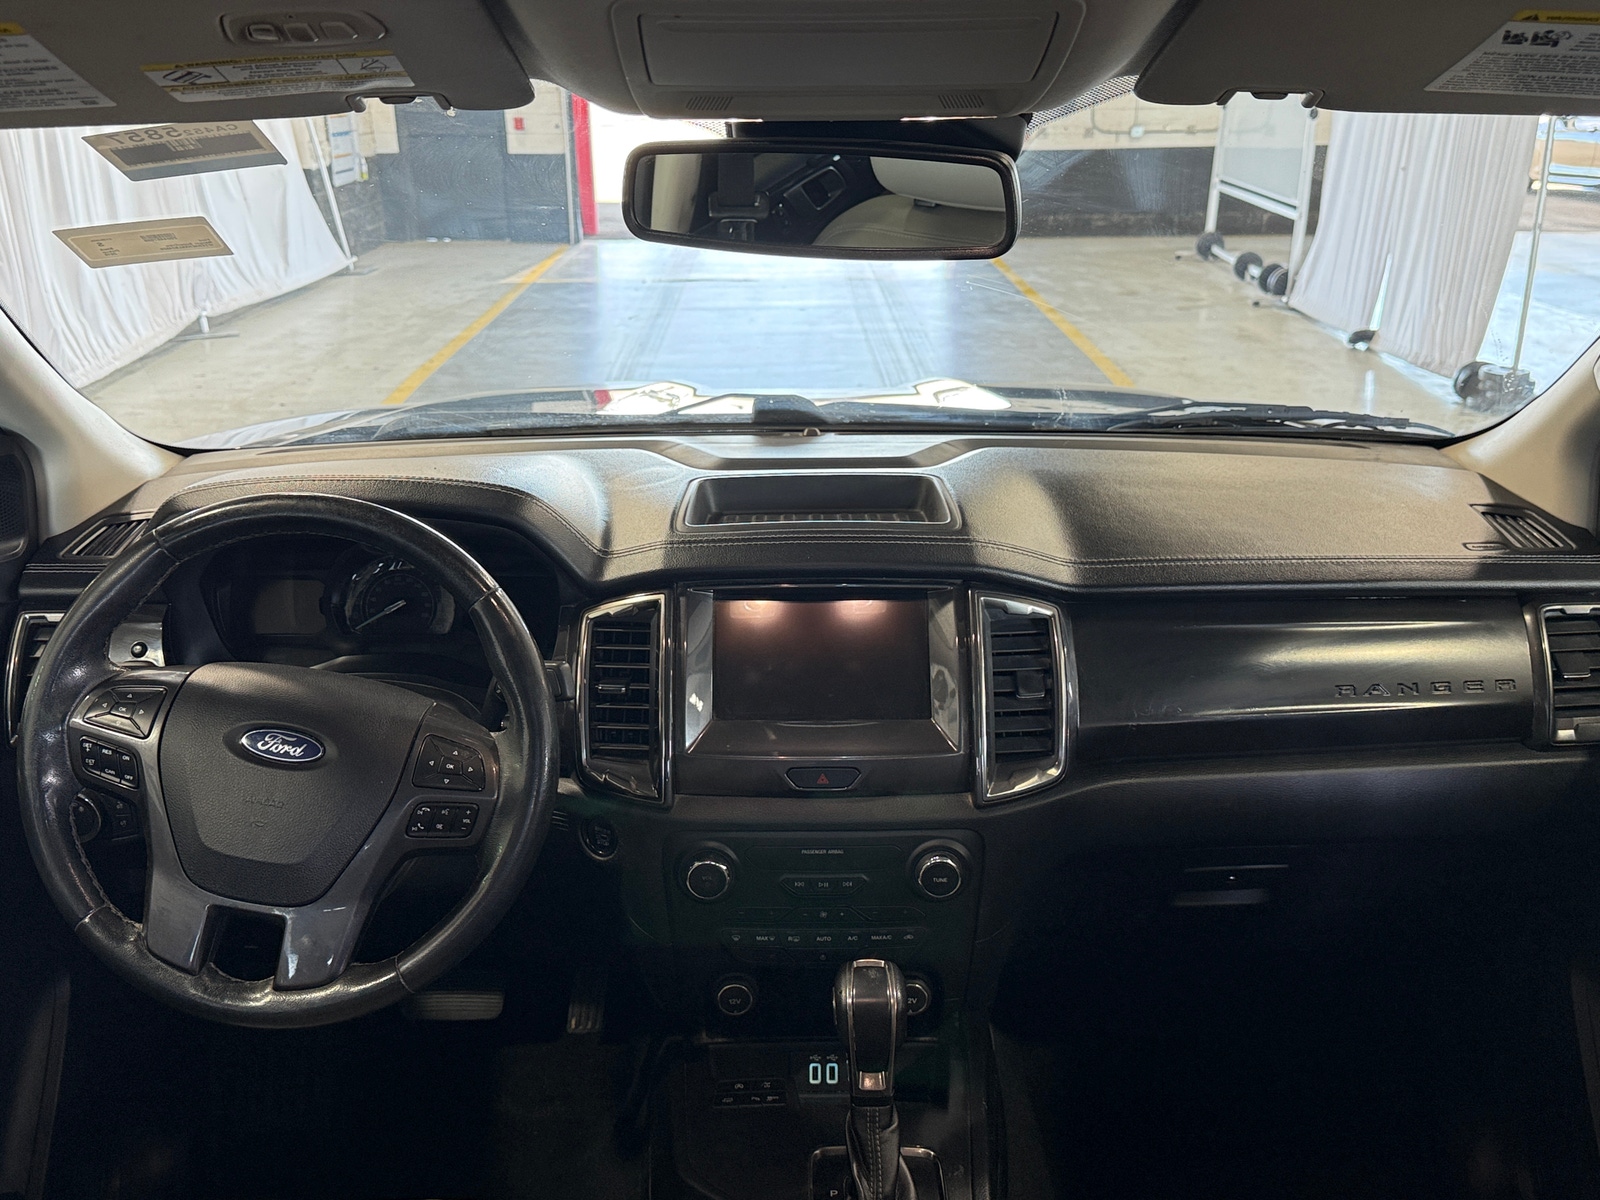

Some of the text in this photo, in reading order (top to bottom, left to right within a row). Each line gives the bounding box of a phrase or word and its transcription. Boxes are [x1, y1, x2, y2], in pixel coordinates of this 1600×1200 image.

[1334, 678, 1517, 698] RANGER
[256, 732, 304, 758] Ford
[829, 1189, 839, 1198] P
